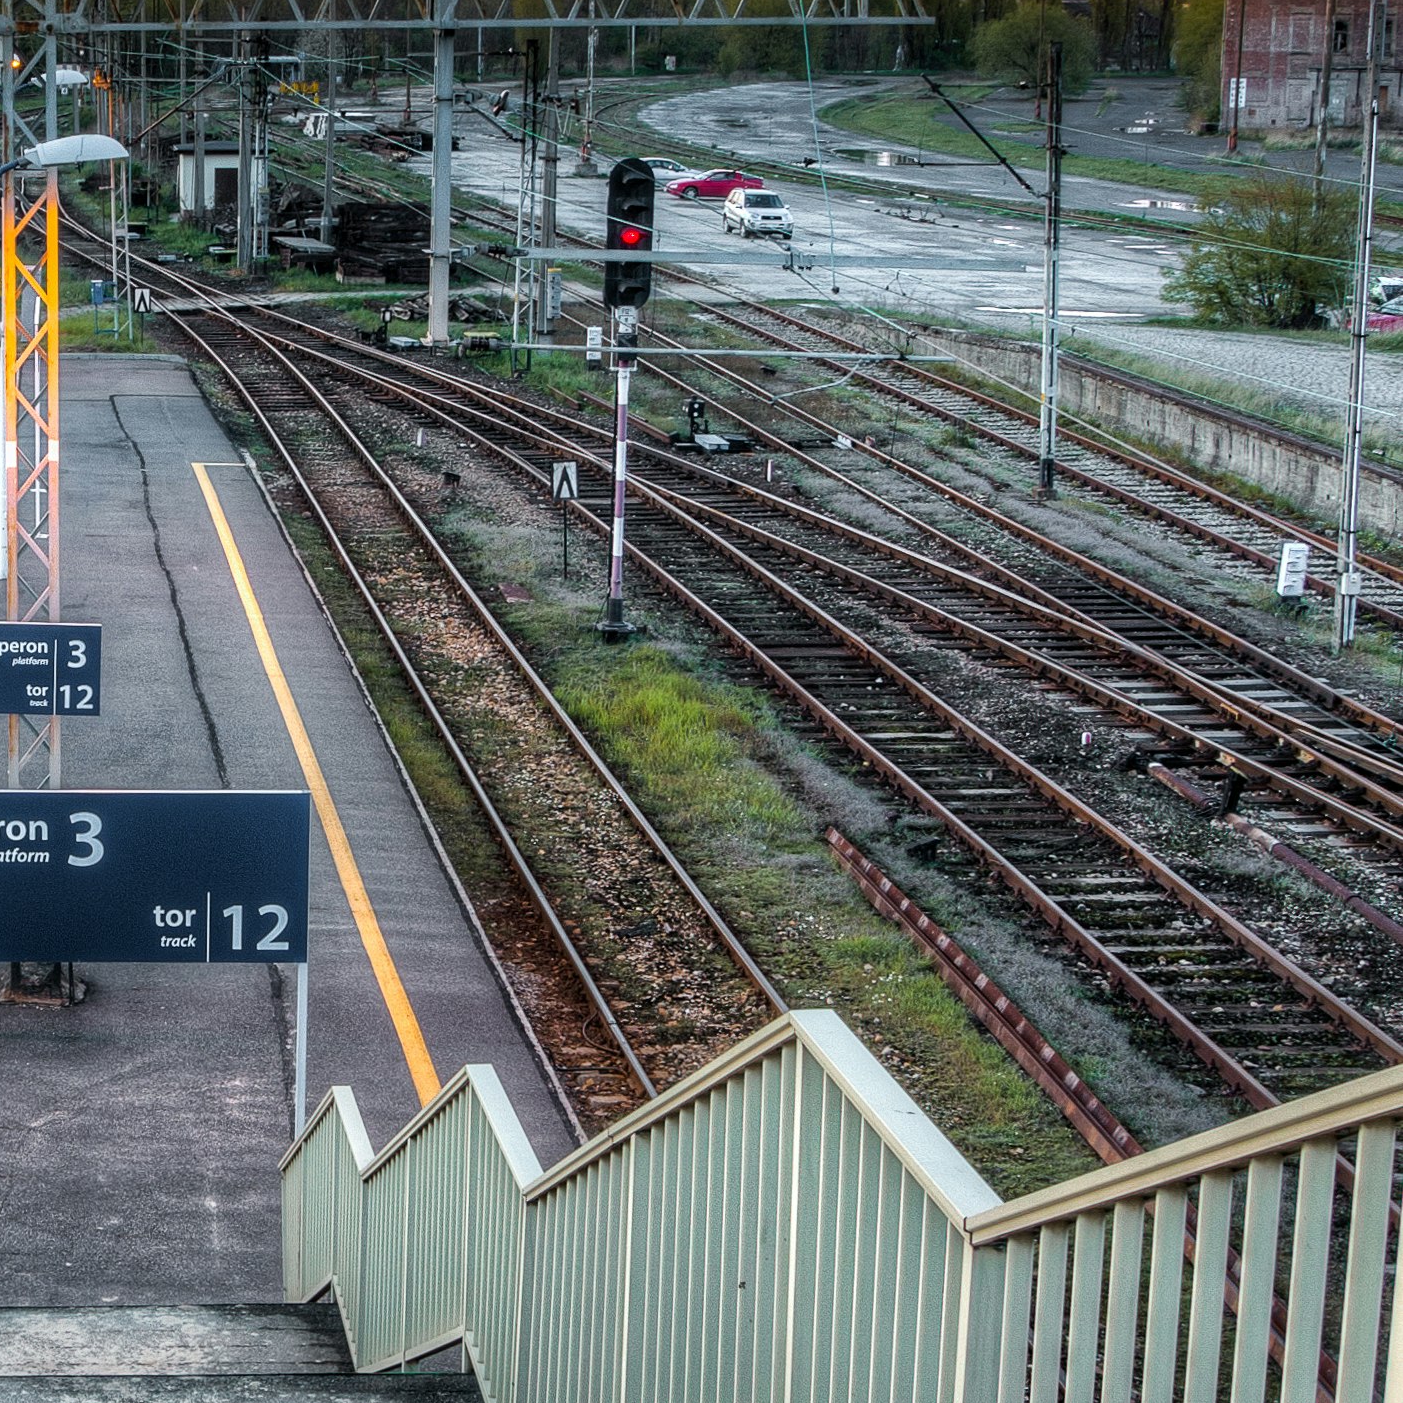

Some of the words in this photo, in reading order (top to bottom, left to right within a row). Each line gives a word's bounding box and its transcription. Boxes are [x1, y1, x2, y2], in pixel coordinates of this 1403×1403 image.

[12, 656, 49, 667] platform
[67, 639, 87, 669] 3
[26, 684, 49, 697] tor
[59, 684, 94, 710] 12
[29, 699, 49, 708] track
[67, 811, 105, 867] 3
[153, 905, 197, 928] tor
[222, 905, 290, 951] 12
[160, 933, 197, 948] track
